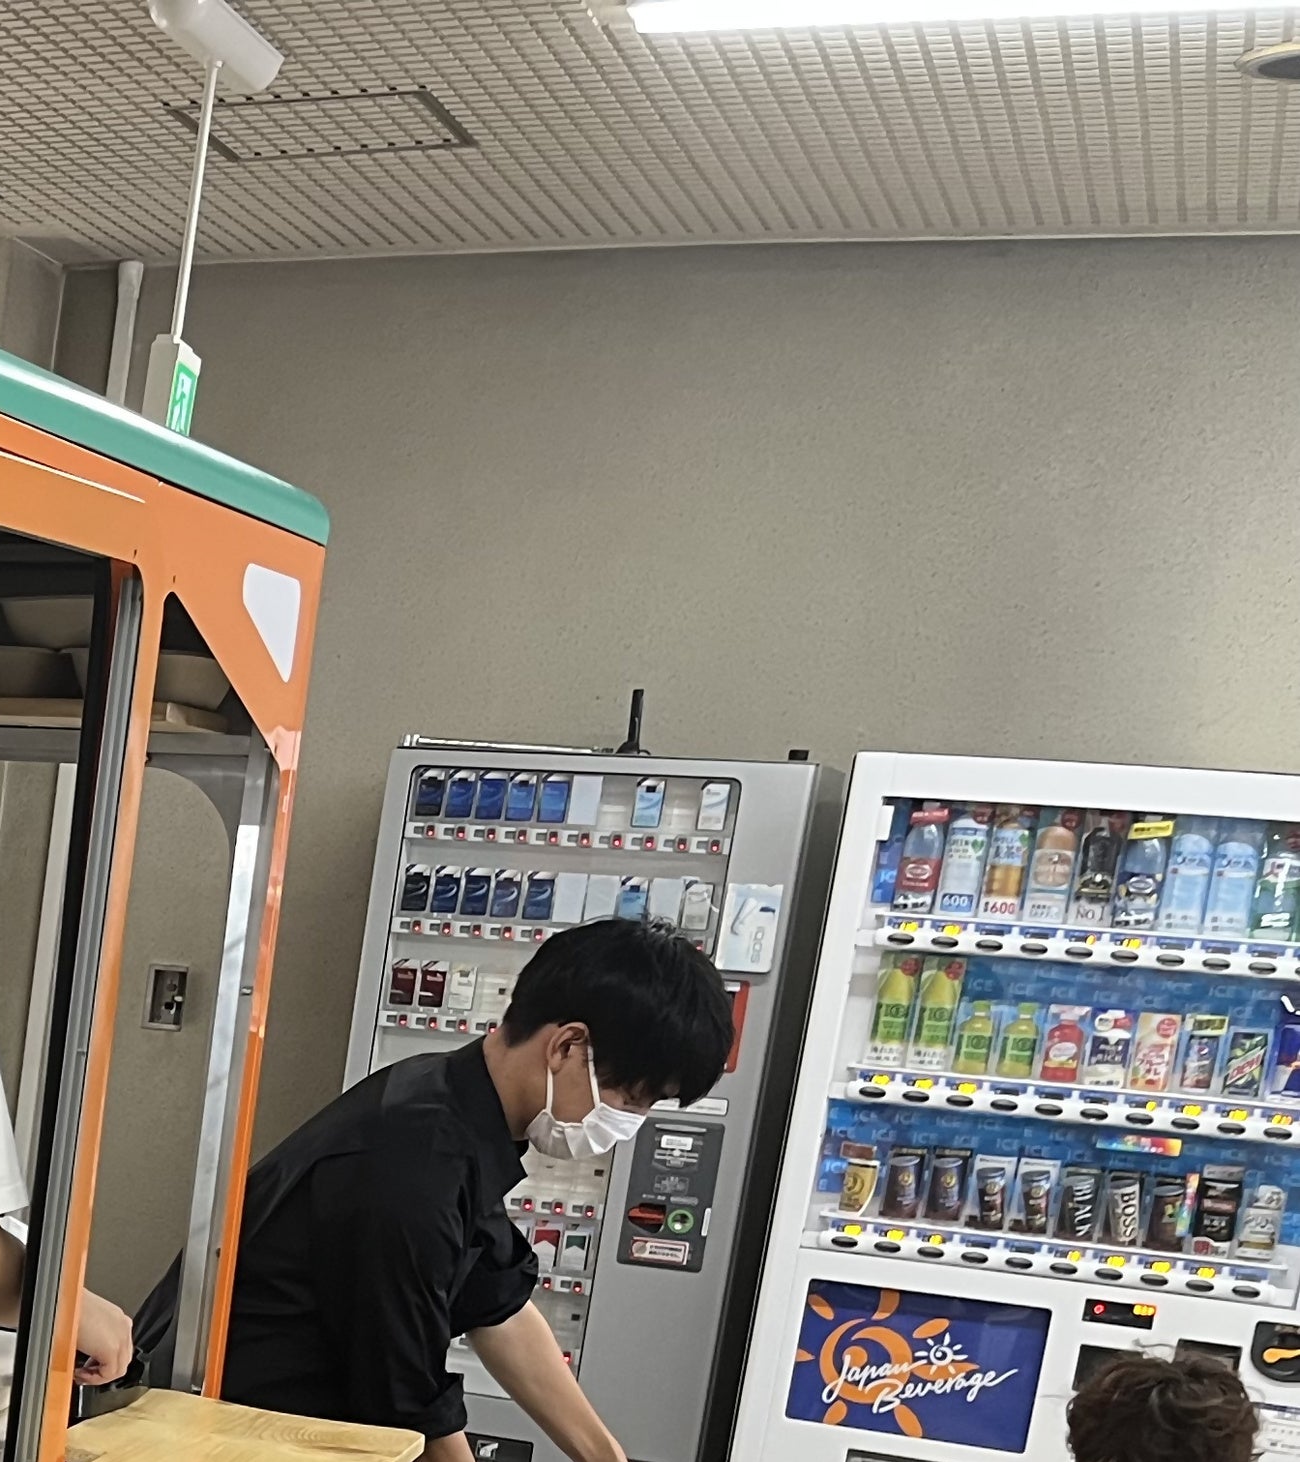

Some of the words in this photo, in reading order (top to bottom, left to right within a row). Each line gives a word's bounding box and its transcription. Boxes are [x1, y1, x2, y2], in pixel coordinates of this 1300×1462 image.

[943, 896, 968, 908] 600
[1072, 1180, 1094, 1238] BLACK
[1120, 1189, 1138, 1243] BOSS
[822, 1354, 928, 1404] Japan
[864, 1368, 1019, 1414] Beverage
